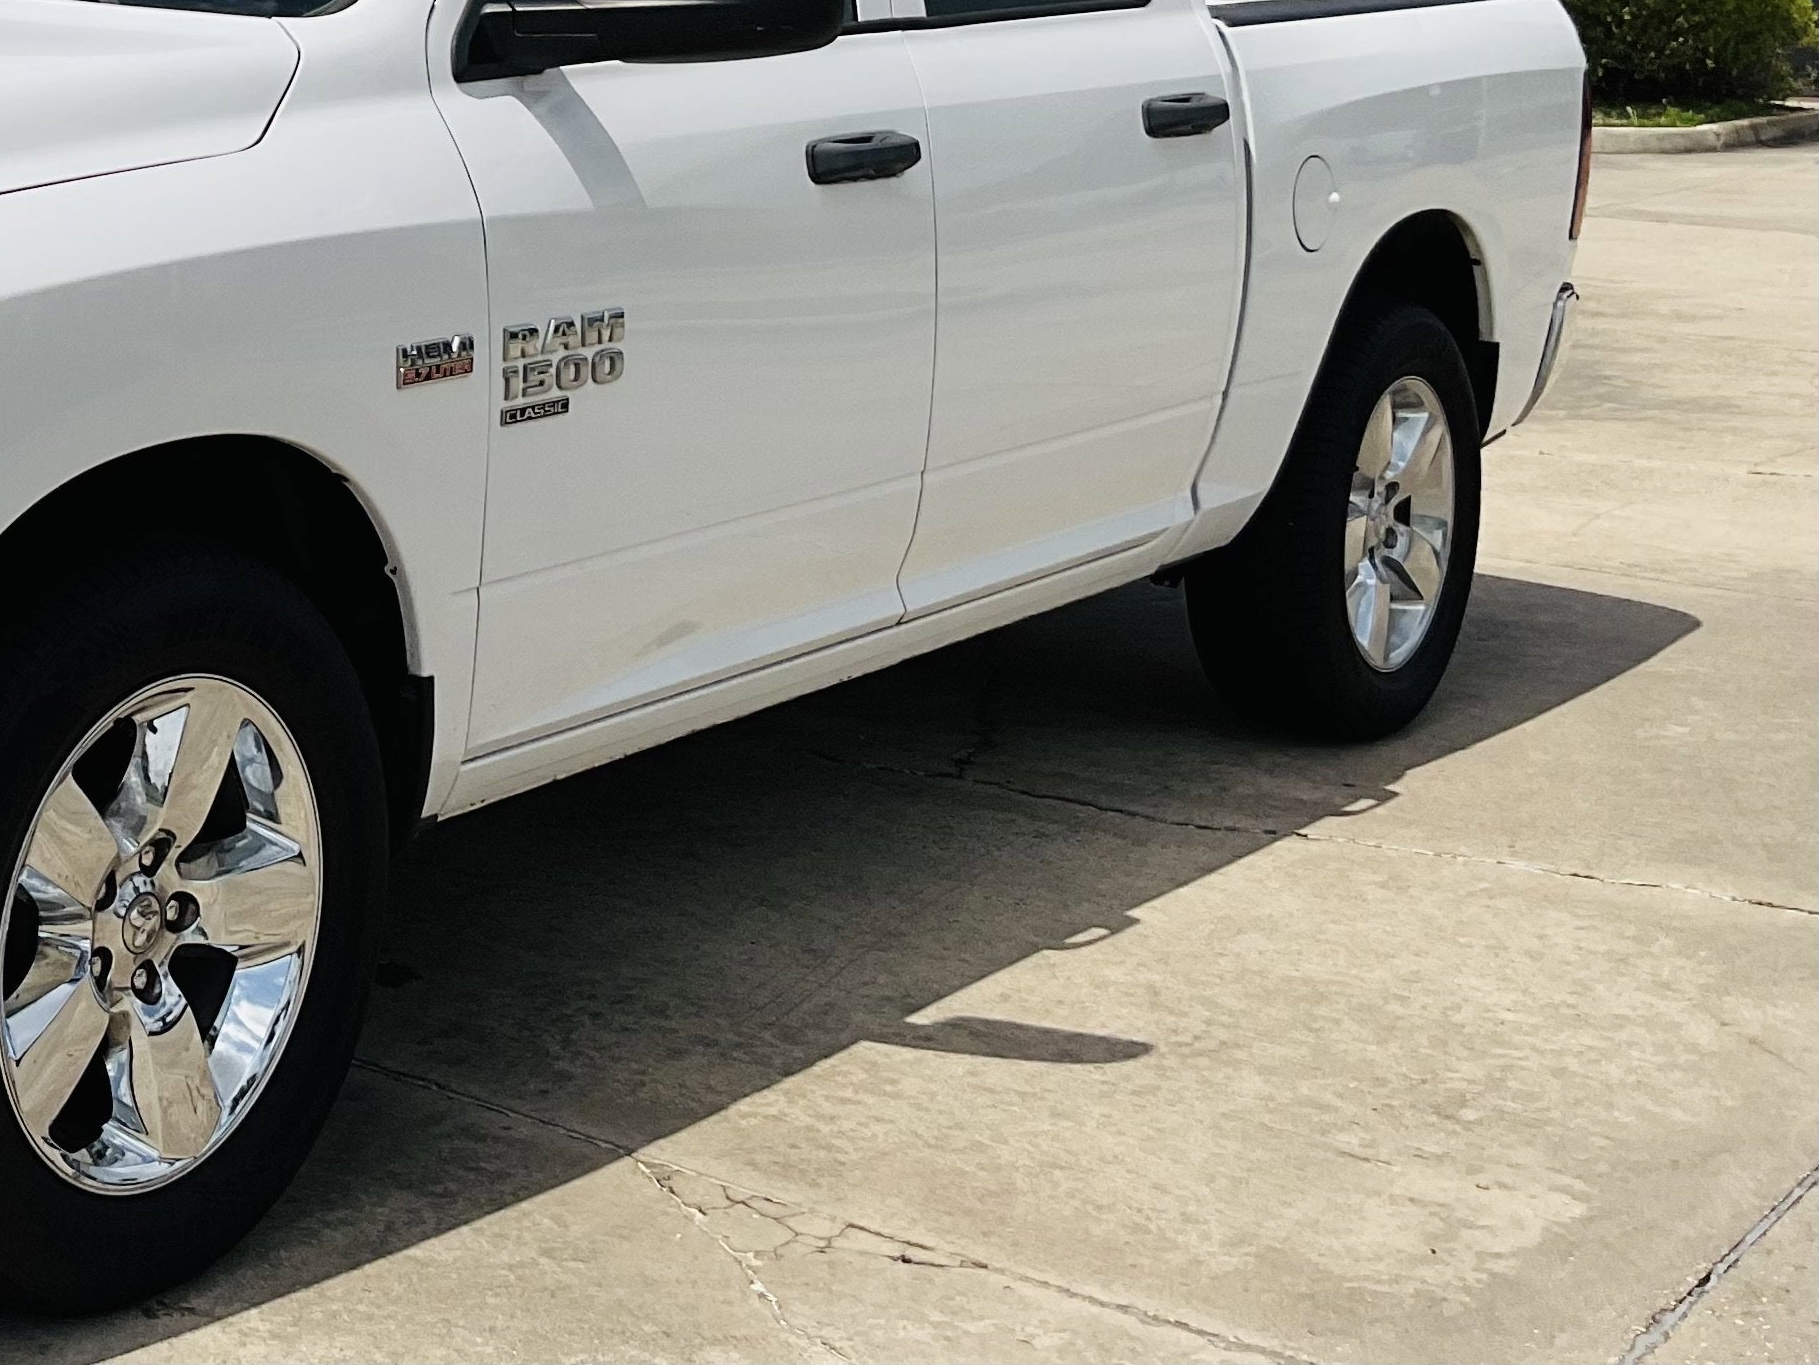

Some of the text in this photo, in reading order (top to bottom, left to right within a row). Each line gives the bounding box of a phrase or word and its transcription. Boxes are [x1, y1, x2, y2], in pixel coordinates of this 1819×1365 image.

[396, 333, 474, 367] HEMI
[502, 307, 626, 363] RAM
[502, 347, 625, 401] 1500
[505, 399, 568, 424] CLASSIC
